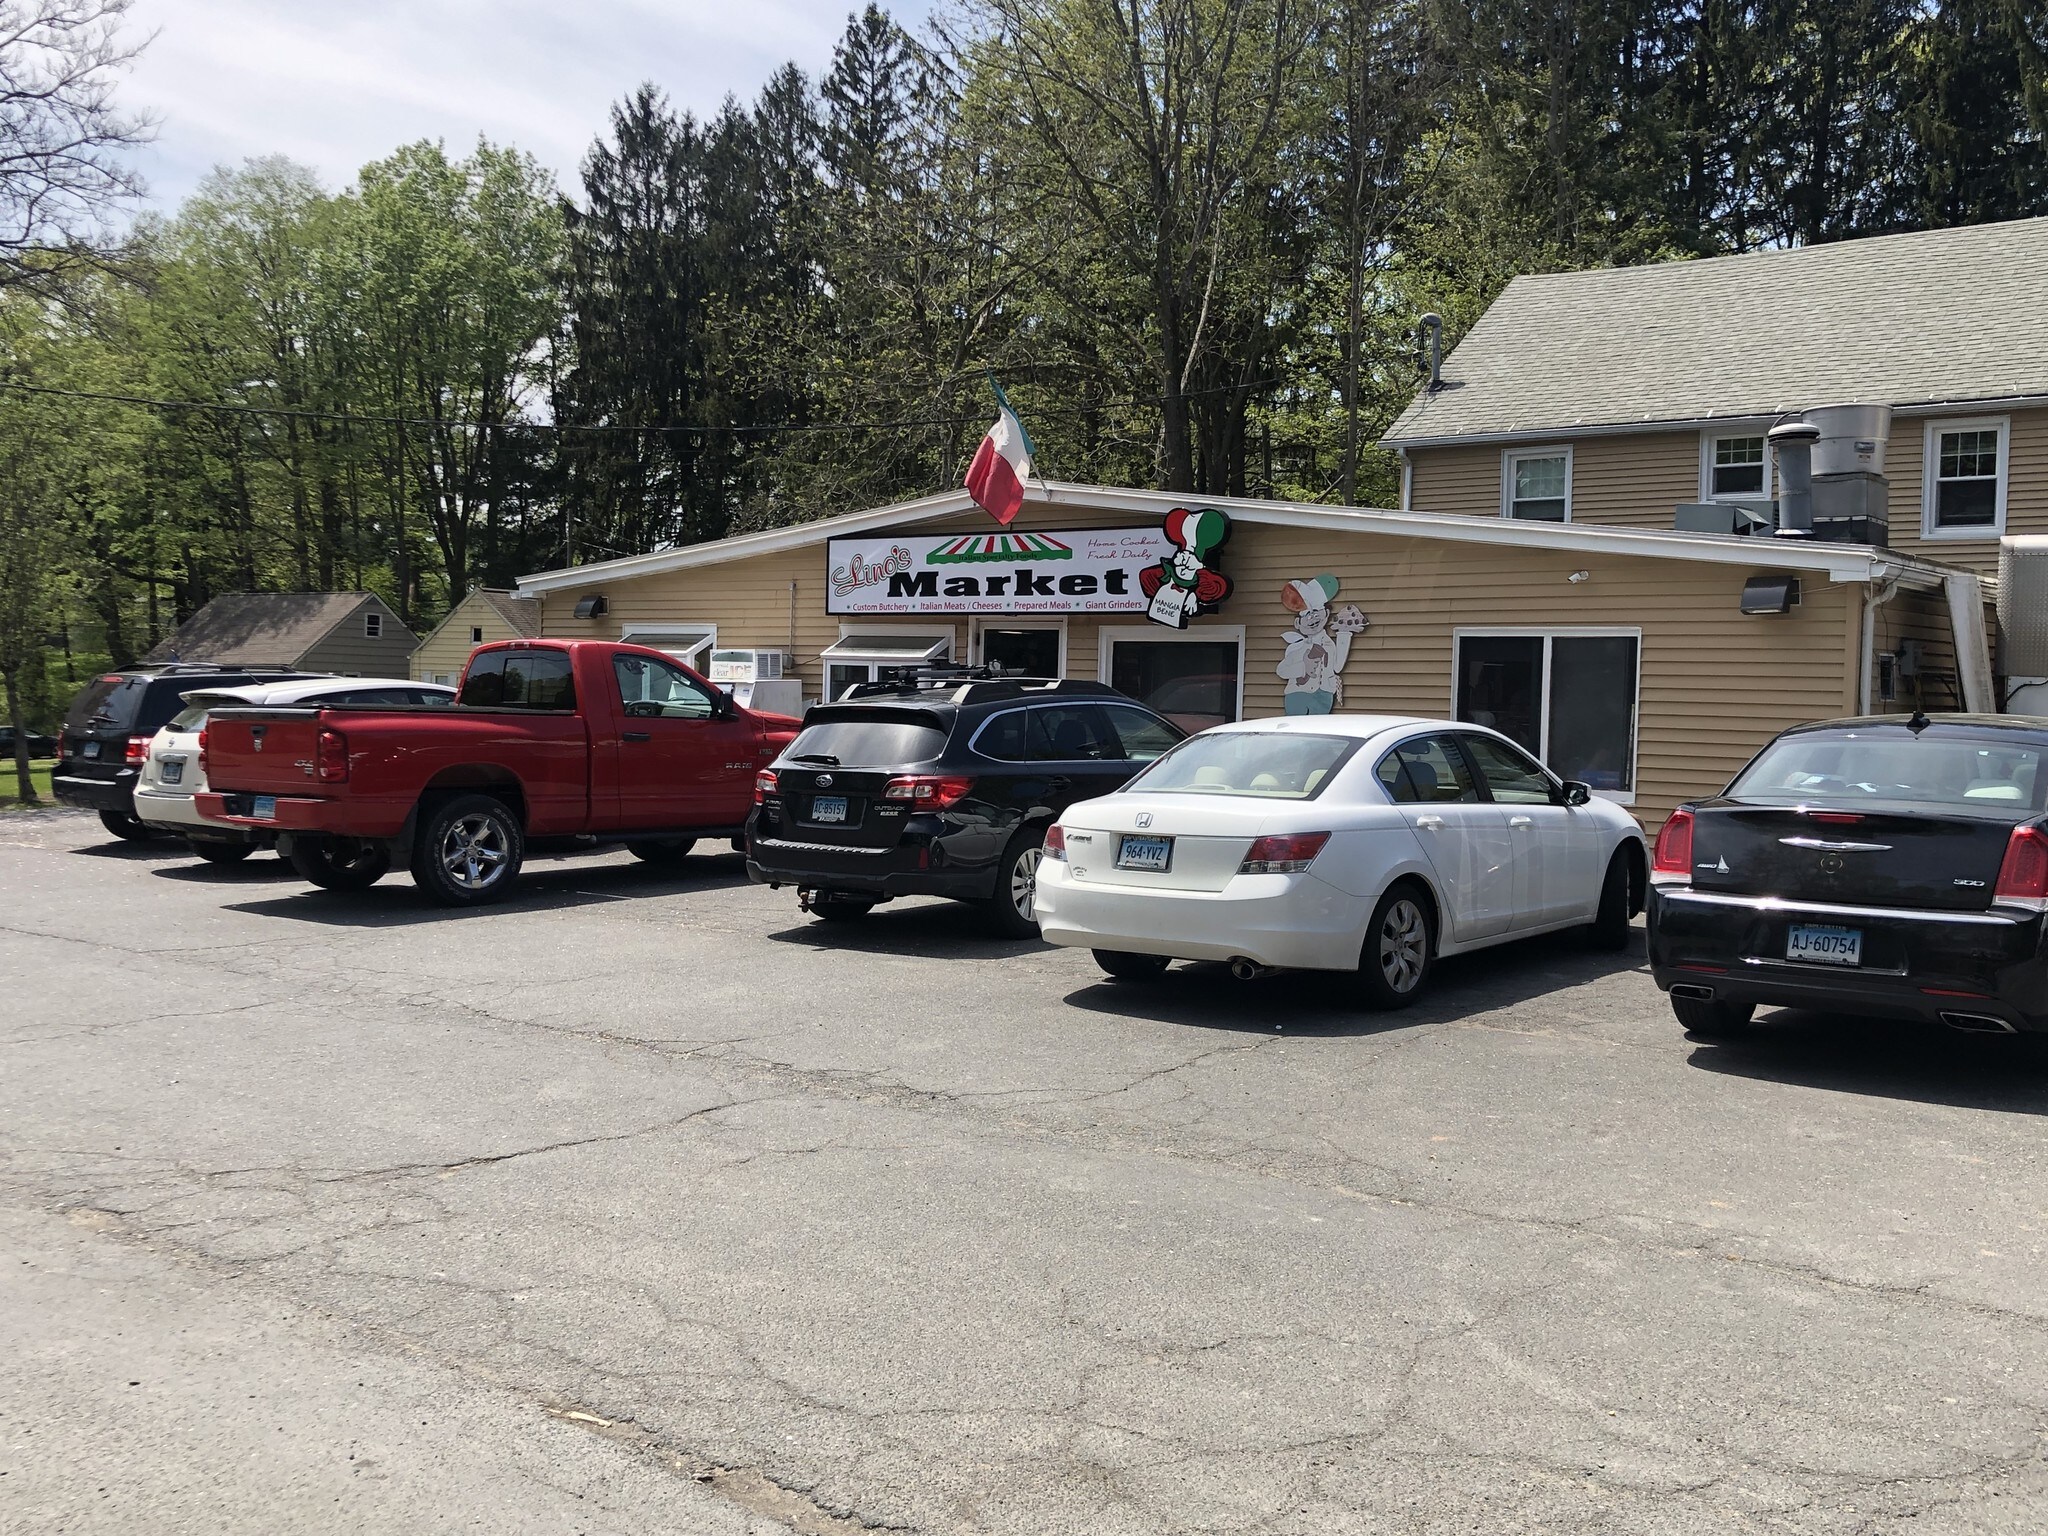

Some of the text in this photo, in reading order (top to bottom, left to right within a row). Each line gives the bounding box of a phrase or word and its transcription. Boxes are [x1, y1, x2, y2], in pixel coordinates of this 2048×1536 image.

[1088, 536, 1160, 548] Home Cooked
[1087, 548, 1153, 561] Fresh Daily
[831, 545, 912, 597] Lino's
[887, 568, 1129, 597] Market
[852, 603, 878, 612] Custom
[879, 603, 909, 613] Butchery
[920, 602, 943, 610] Italian
[944, 602, 966, 610] Meats
[972, 601, 1003, 610] Cheeses
[1014, 601, 1048, 611] Prepared
[1050, 601, 1072, 610] Meals
[1085, 601, 1107, 609] Giant
[1108, 600, 1142, 609] Grinders
[1155, 599, 1180, 611] MANGIA
[1157, 607, 1175, 617] BENE
[1953, 879, 1986, 887] 300
